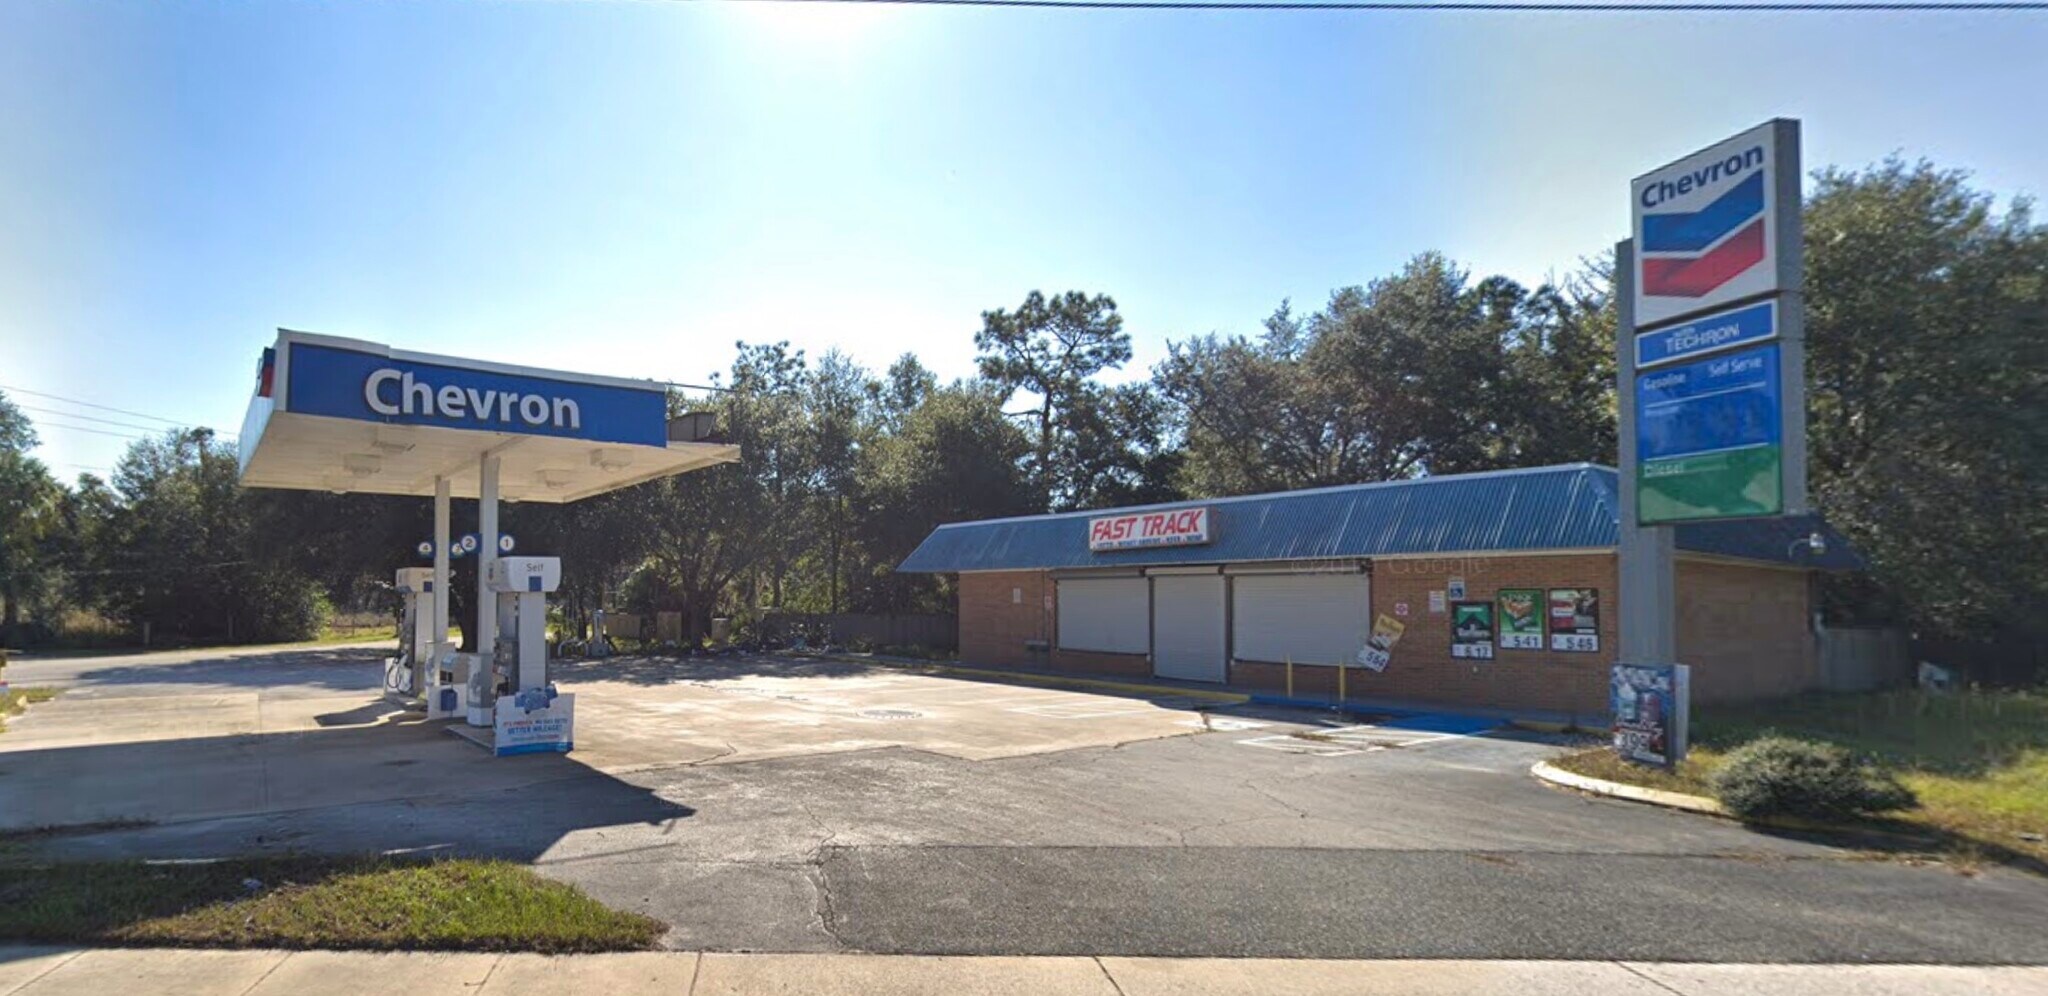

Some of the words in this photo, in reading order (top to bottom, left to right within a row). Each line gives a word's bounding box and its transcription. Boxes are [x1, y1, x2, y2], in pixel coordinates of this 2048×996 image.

[1640, 144, 1764, 209] Chevron
[1665, 322, 1741, 354] TECHRON
[1642, 373, 1687, 391] Gasoline
[1708, 360, 1730, 378] Self
[1731, 356, 1763, 374] Serve
[364, 367, 581, 430] Chevron
[1643, 460, 1684, 476] Diesel
[1091, 517, 1138, 541] FAST
[1142, 510, 1203, 537] TRACK
[526, 562, 544, 572] Self
